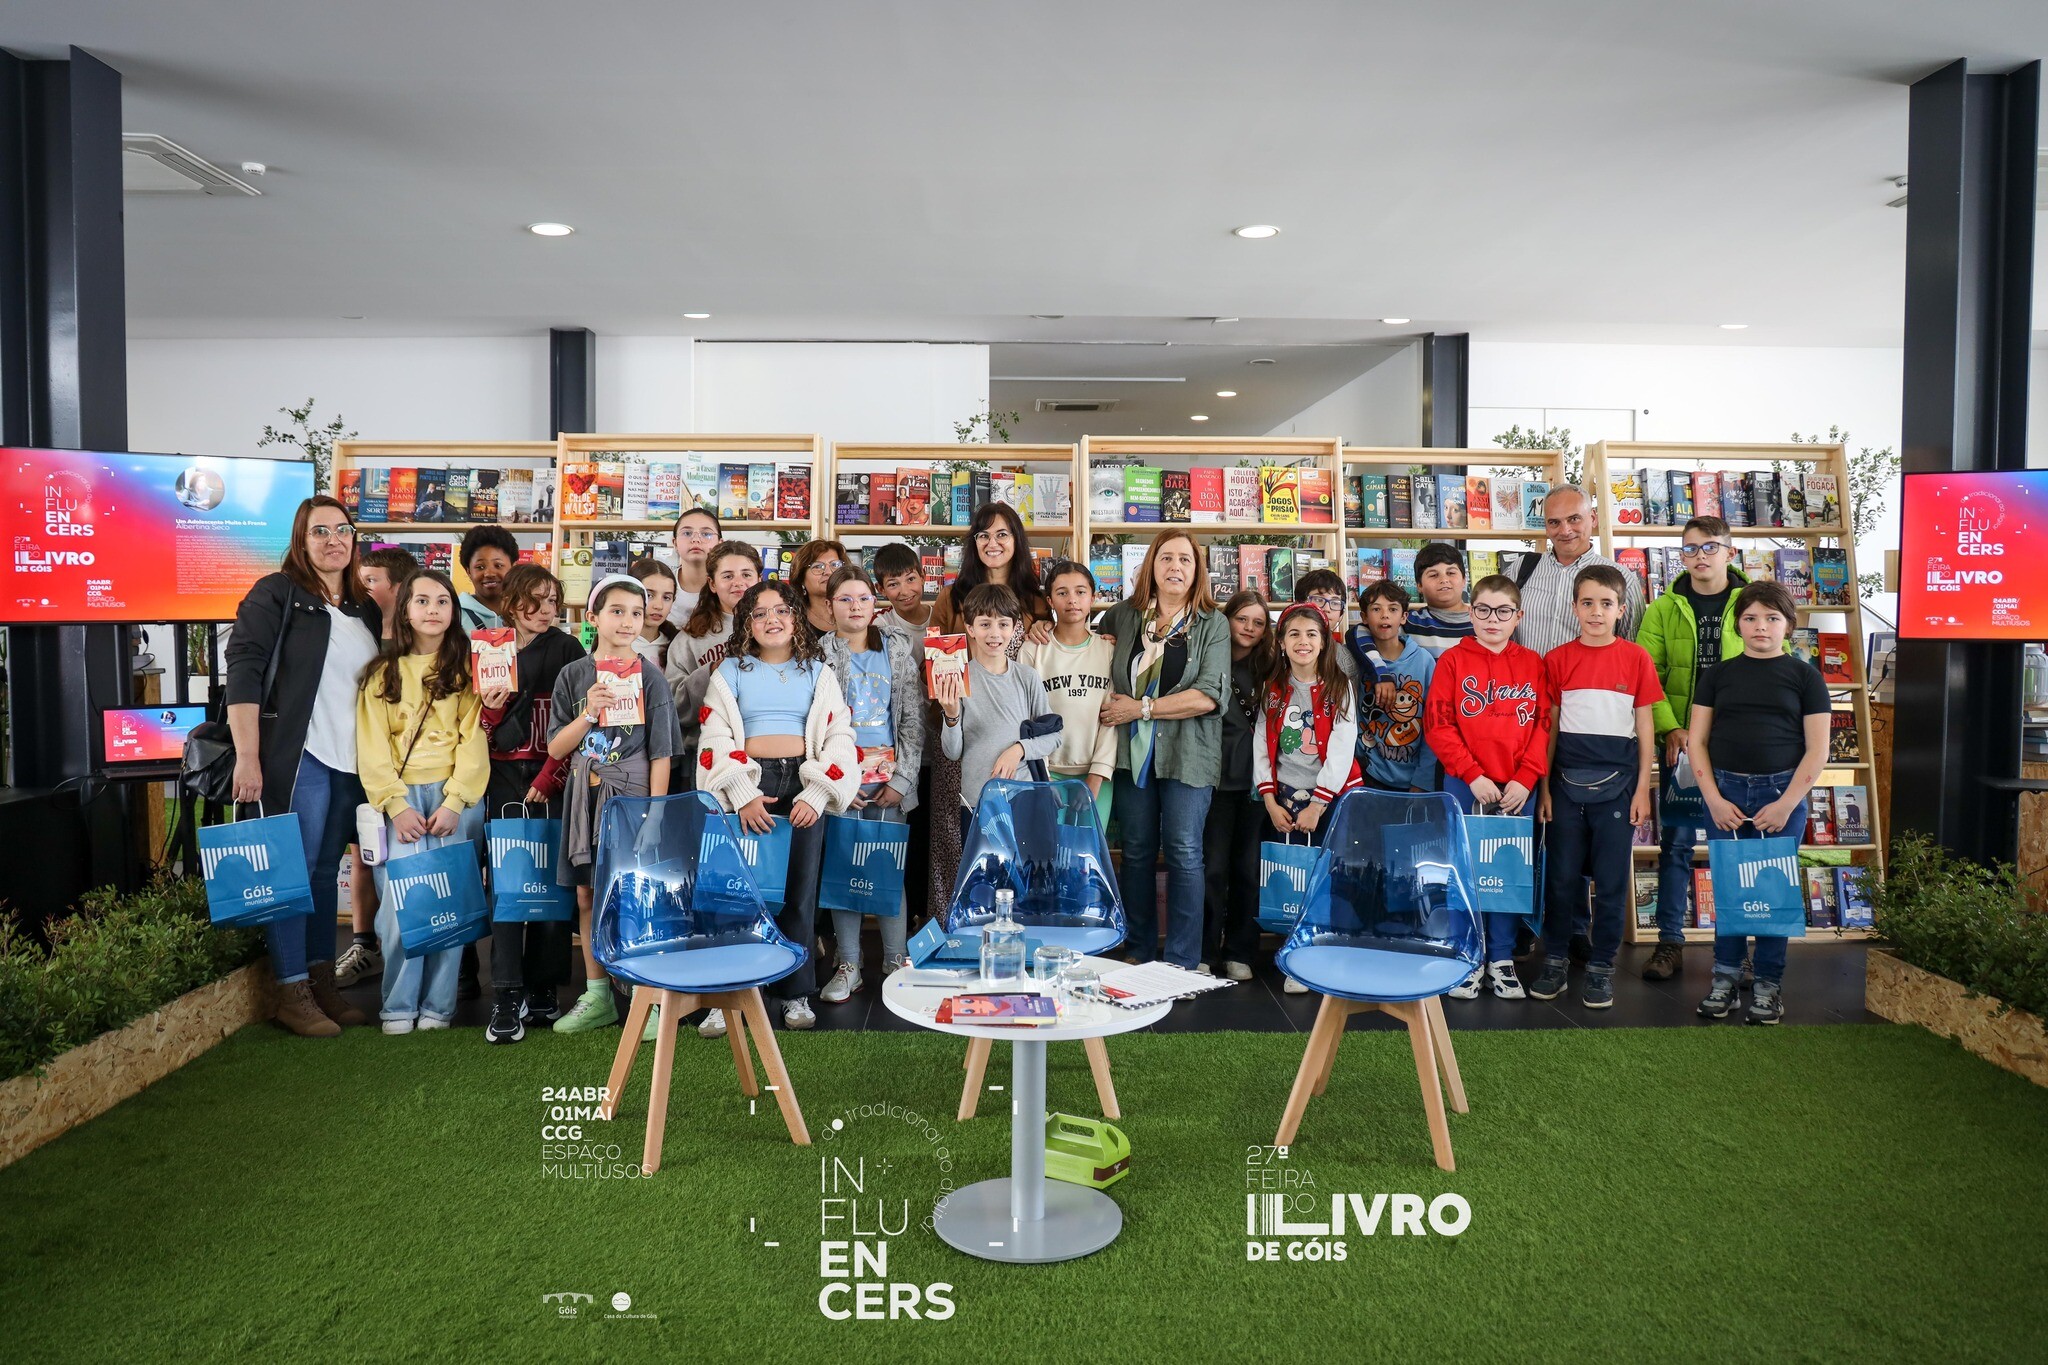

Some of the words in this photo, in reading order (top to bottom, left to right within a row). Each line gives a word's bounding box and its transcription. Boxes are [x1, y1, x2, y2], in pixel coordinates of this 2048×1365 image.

[687, 471, 716, 482] Modignani
[45, 486, 62, 498] IN
[1807, 481, 1835, 492] FOGAÇA
[46, 498, 78, 510] FLU
[564, 503, 595, 514] WALSH
[1676, 503, 1693, 514] ALA
[46, 512, 70, 522] EN
[1618, 509, 1641, 524] 80
[1960, 507, 1975, 518] IN
[46, 524, 94, 536] CERS
[1959, 520, 1989, 530] FLU
[1958, 532, 1981, 543] EN
[1957, 544, 2004, 556] CERS
[30, 564, 52, 572] GÓIS
[1784, 577, 1805, 585] REGRA
[1214, 584, 1233, 600] pai
[481, 666, 506, 678] MUITO
[1043, 674, 1073, 693] NEW
[1080, 674, 1110, 690] YORK
[1068, 689, 1087, 697] 1997
[850, 878, 873, 890] Góis
[1479, 876, 1503, 887] Góis
[243, 885, 273, 899] Góis
[523, 882, 547, 894] Góis
[1743, 901, 1770, 912] Góis
[430, 912, 456, 926] Góis
